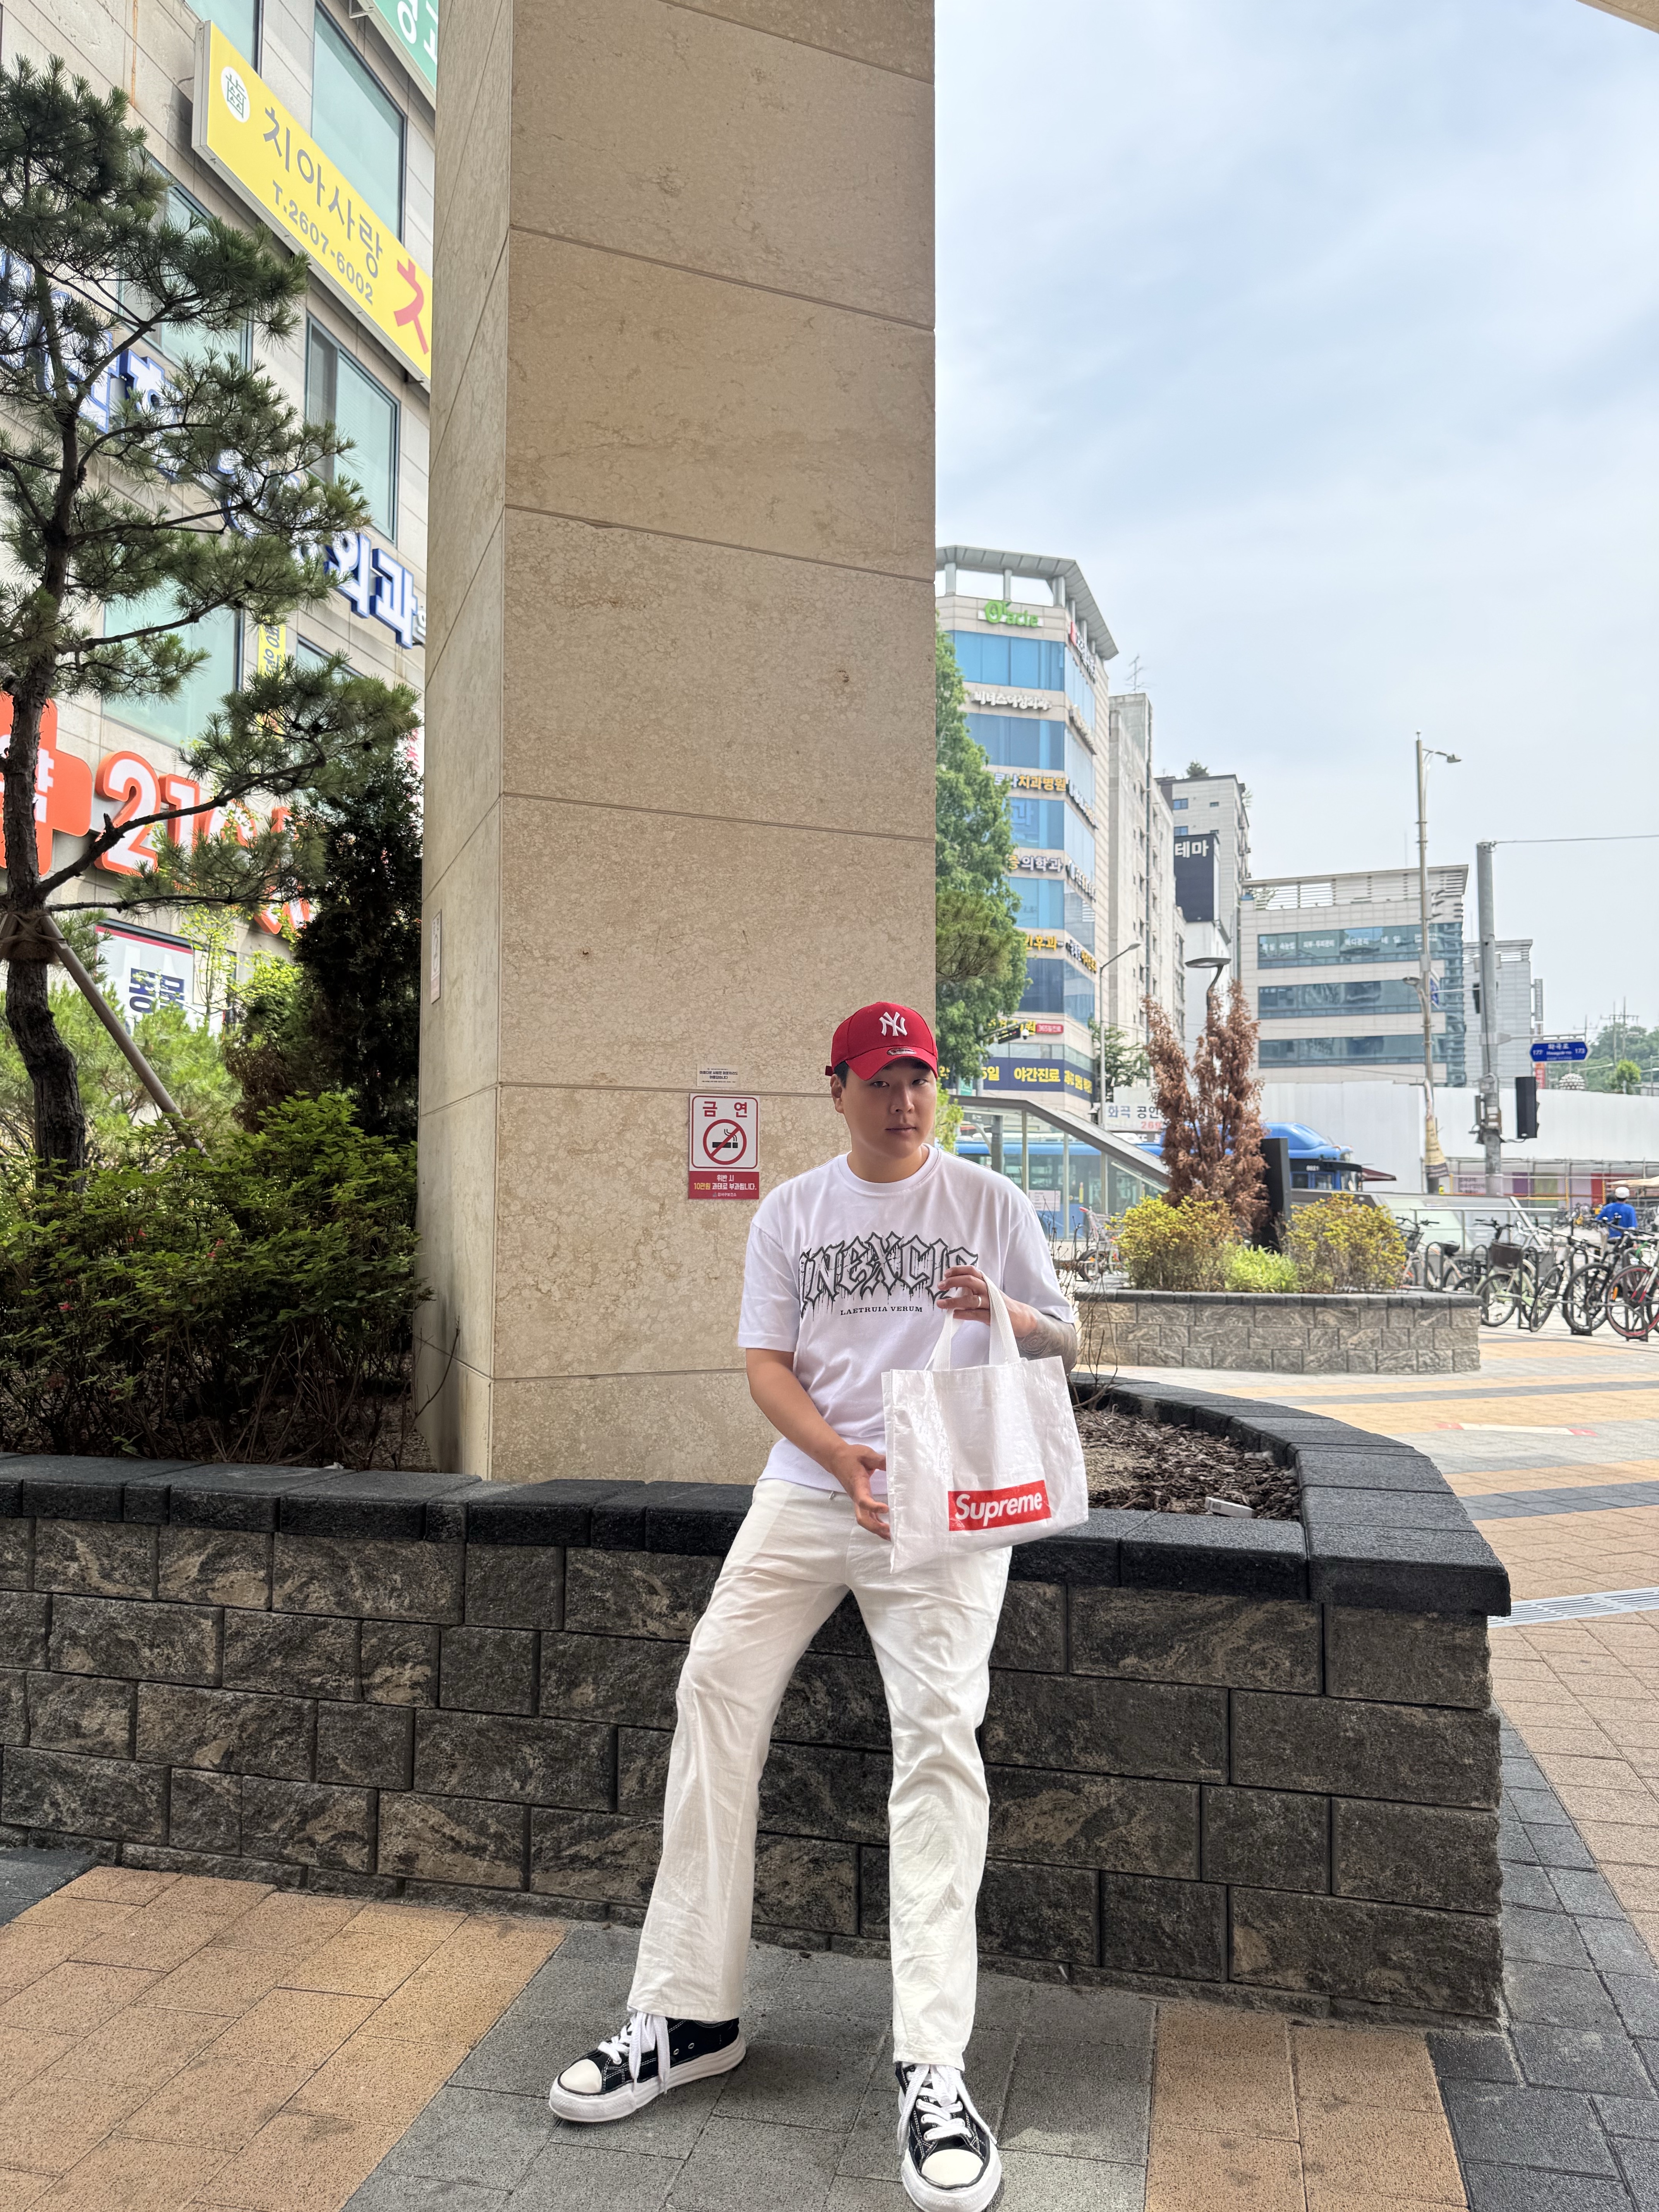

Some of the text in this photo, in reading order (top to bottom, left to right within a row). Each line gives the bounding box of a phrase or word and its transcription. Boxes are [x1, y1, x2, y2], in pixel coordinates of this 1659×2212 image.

[263, 106, 383, 278] 치아사랑
[272, 180, 373, 306] T.2607-6002
[1175, 840, 1209, 858] 테마
[879, 1012, 907, 1036] NY
[1014, 1067, 1061, 1082] 야간진료
[1108, 1105, 1159, 1119] 화곡 공인
[840, 1306, 888, 1316] LAETRUIA
[955, 1492, 1042, 1527] Supreme
